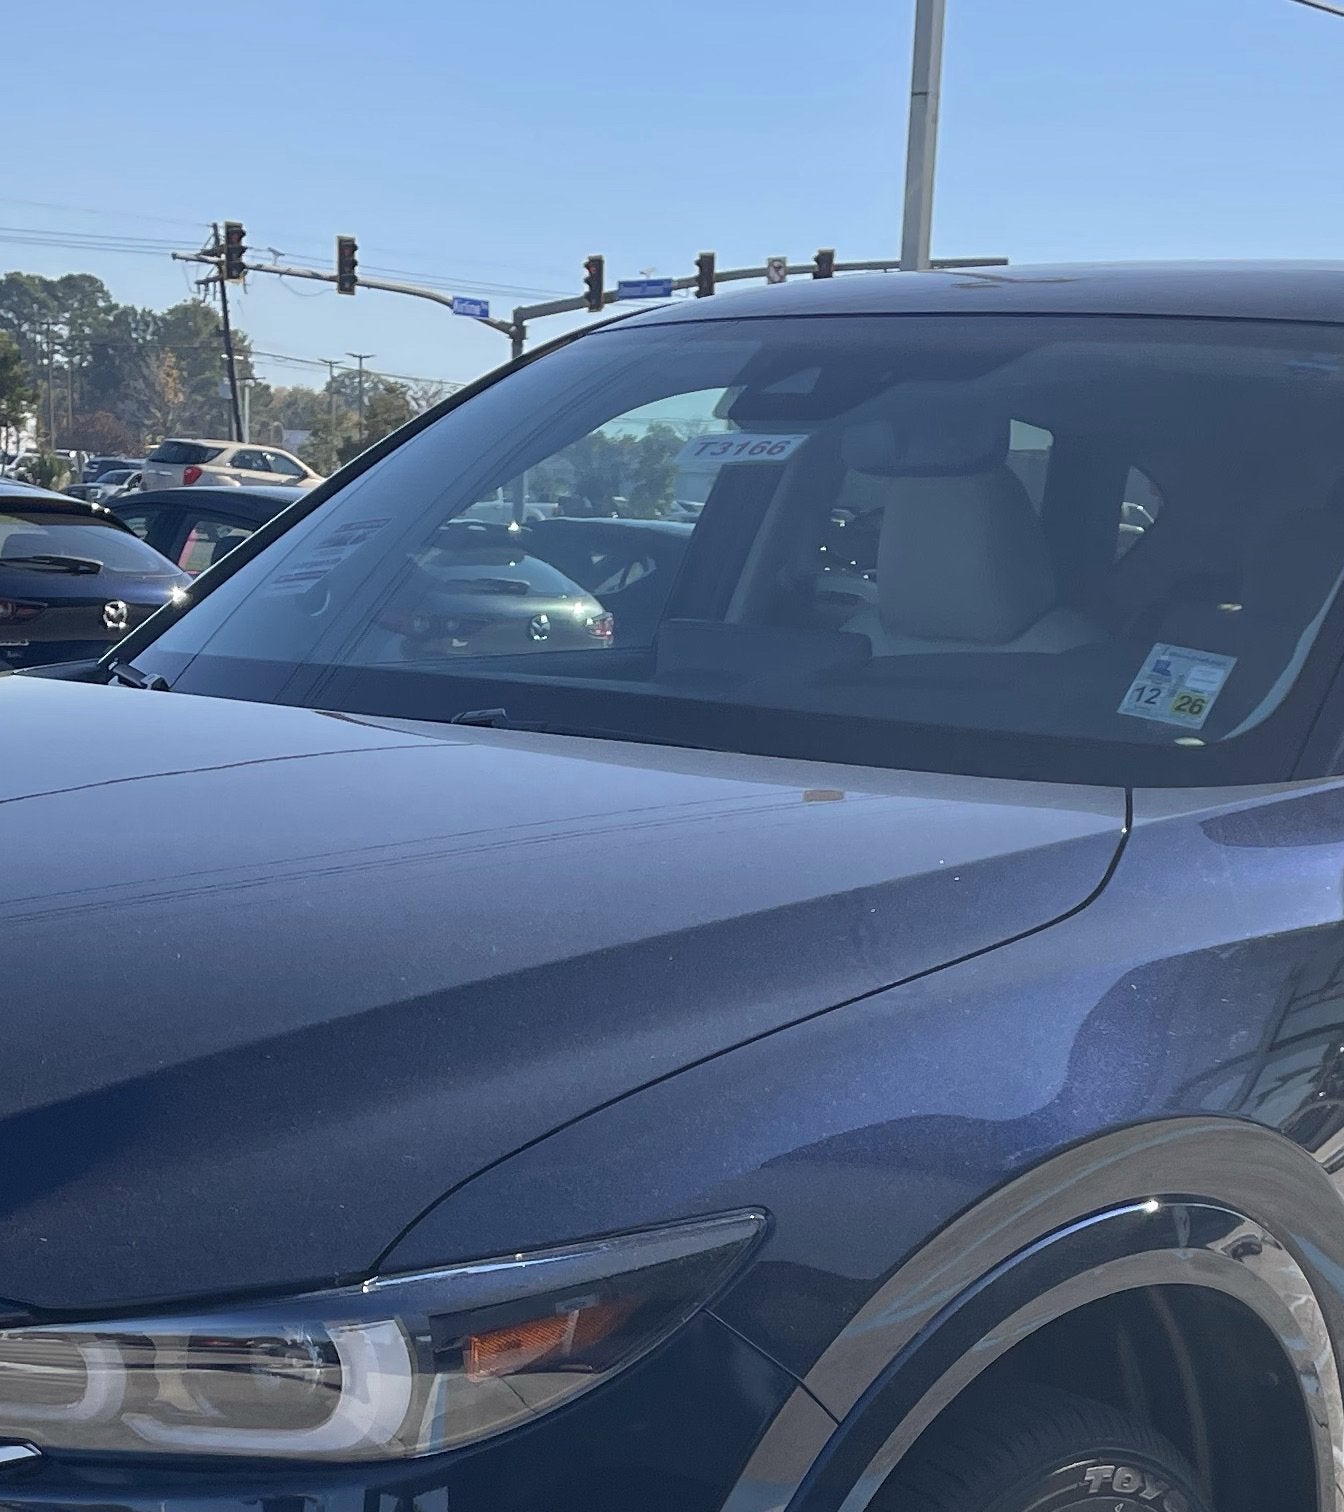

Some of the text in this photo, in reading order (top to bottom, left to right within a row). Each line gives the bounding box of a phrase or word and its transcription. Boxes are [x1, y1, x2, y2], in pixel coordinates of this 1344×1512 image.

[694, 440, 792, 457] T3166
[1134, 685, 1206, 715] 12 26
